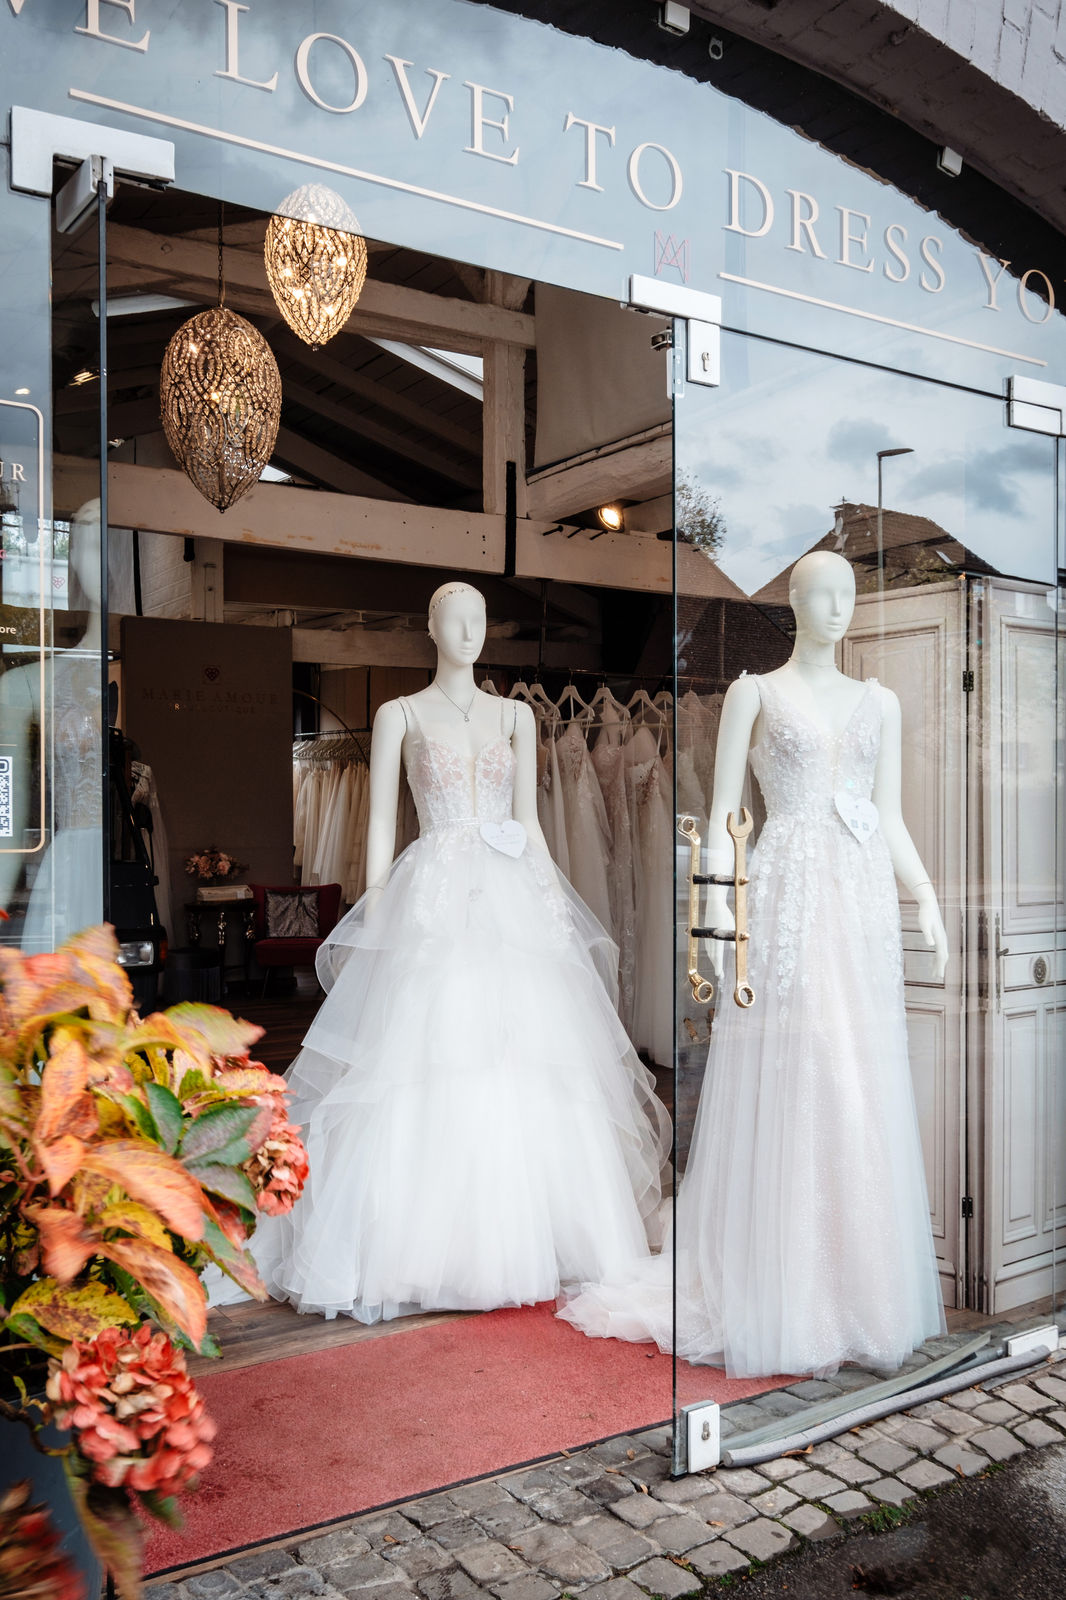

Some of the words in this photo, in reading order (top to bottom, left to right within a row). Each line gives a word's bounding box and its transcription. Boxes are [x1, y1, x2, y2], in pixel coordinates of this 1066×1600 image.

[212, 0, 519, 166] LOVE
[563, 112, 684, 211] TO
[721, 168, 946, 293] DRESS
[974, 251, 1062, 324] YO
